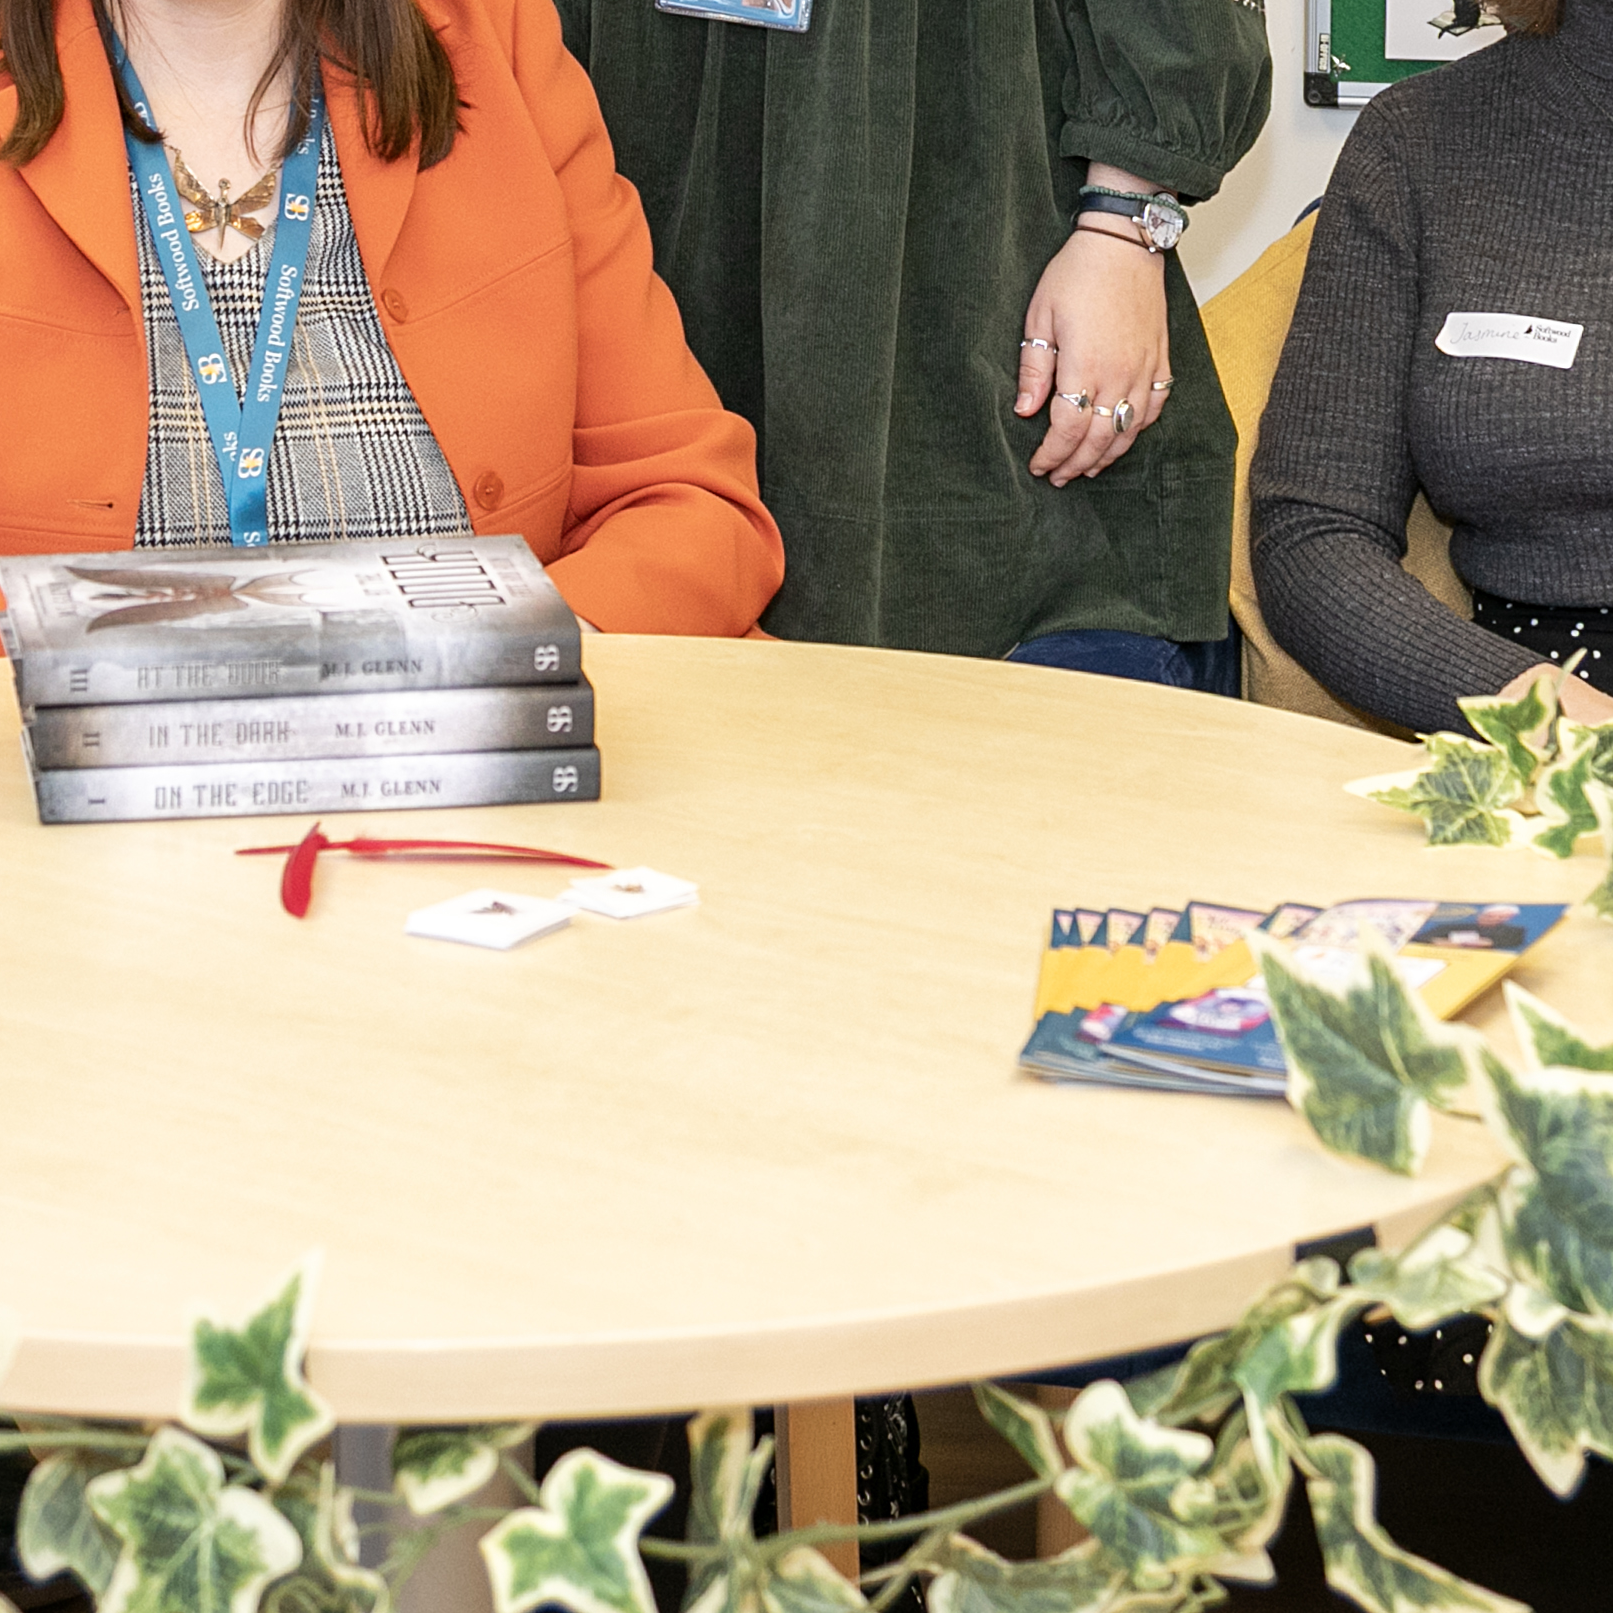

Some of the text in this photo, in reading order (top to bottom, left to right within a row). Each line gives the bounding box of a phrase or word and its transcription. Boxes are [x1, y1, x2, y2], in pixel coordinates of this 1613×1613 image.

[147, 172, 199, 312] Softwood Books
[256, 264, 298, 403] Softwood Books
[1450, 323, 1519, 344] Jasmine
[362, 659, 423, 674] GLENN
[149, 725, 169, 748] IN
[180, 723, 223, 747] THE
[237, 720, 289, 745] DARK
[374, 720, 436, 736] GLENN
[155, 786, 182, 810] ON
[193, 783, 237, 807] THE
[253, 780, 309, 806] EDGE
[381, 779, 442, 797] GLENN
